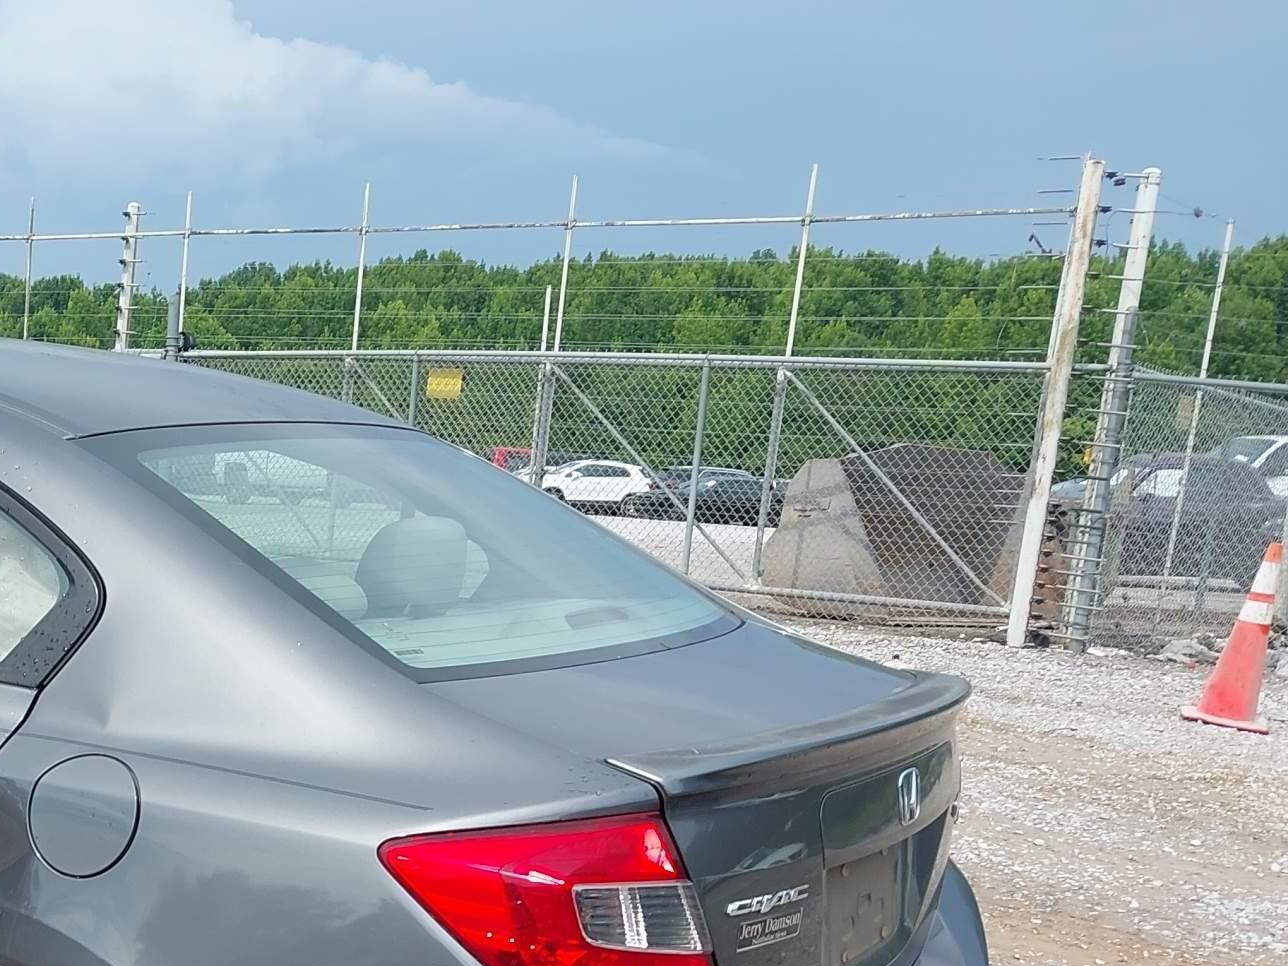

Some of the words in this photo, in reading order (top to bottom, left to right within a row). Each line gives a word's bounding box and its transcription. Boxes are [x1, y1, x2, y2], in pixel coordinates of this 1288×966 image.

[726, 884, 810, 917] CIVIC
[739, 921, 765, 940] Jerry
[765, 912, 801, 933] Damson
